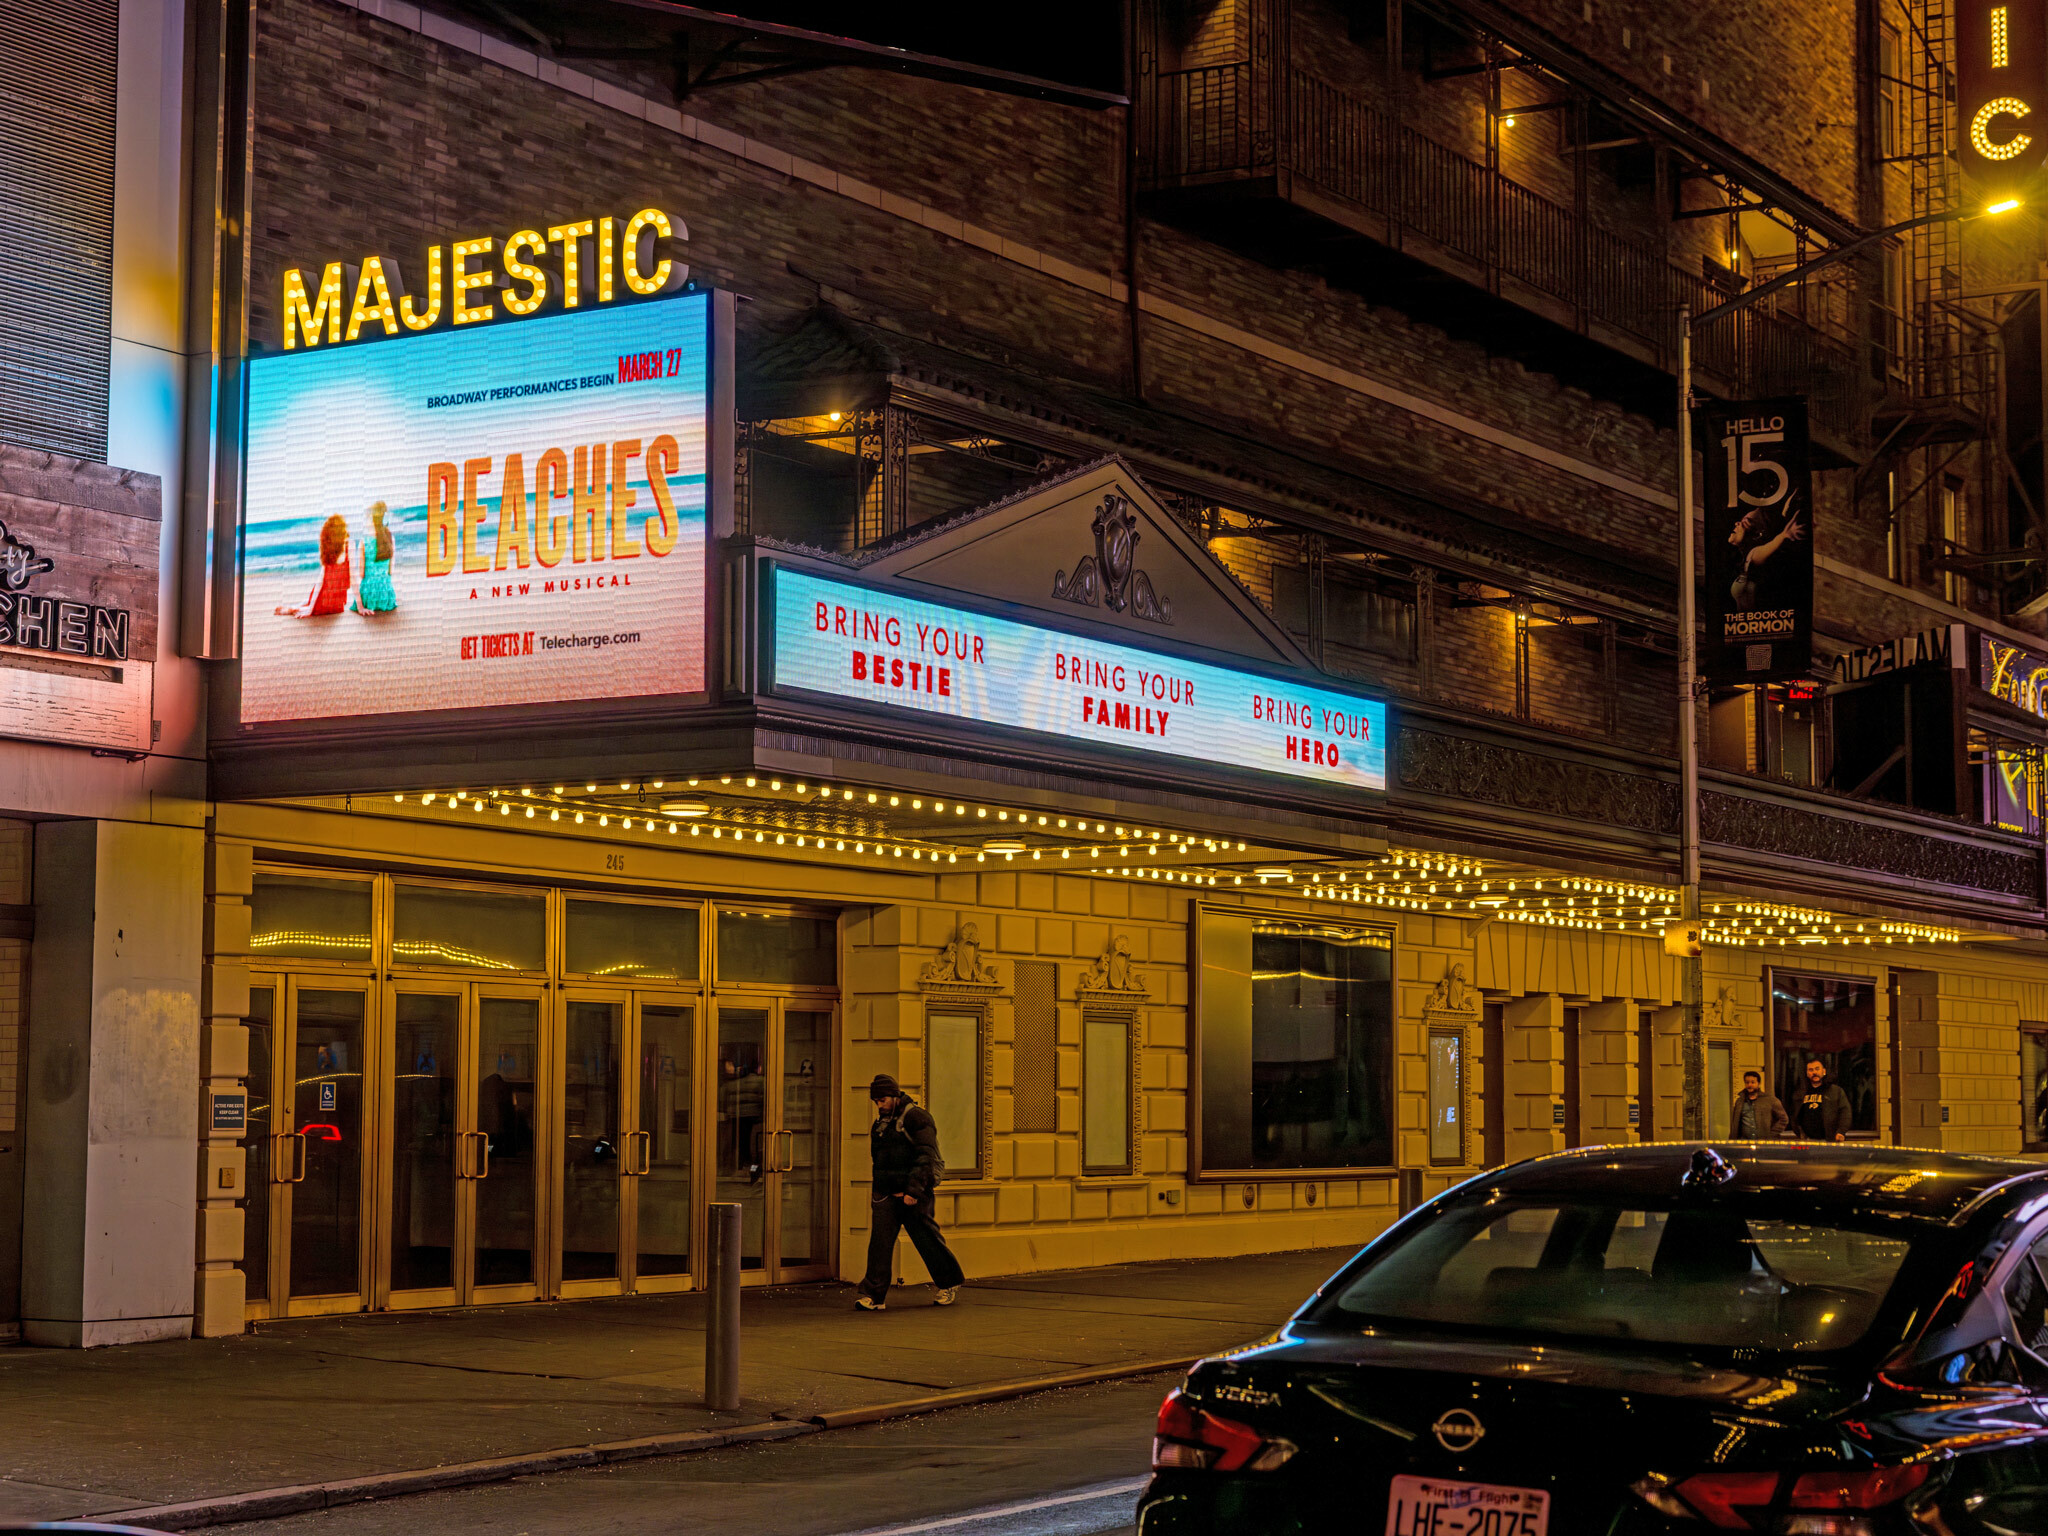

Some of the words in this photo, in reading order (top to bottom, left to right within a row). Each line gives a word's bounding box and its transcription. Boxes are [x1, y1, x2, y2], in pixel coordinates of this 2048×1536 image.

[282, 208, 673, 350] MAJESTIC
[427, 389, 488, 409] BROADWAY
[490, 377, 578, 401] PERFORMANCES
[580, 373, 615, 390] BEGIN
[618, 350, 663, 384] MARCH
[666, 348, 682, 377] 27
[1726, 416, 1785, 435] HELLO
[1721, 432, 1789, 508] 15
[426, 434, 680, 578] BEACHES
[470, 588, 478, 600] A
[492, 583, 530, 598] NEW
[544, 574, 631, 593] MUSICAL
[816, 601, 901, 647] BRING
[916, 622, 984, 664] YOUR
[1724, 612, 1745, 622] THE
[1747, 610, 1778, 620] BOOK
[1779, 609, 1795, 619] OF
[1724, 618, 1795, 635] MORMON
[461, 637, 479, 660] GET
[481, 632, 520, 659] TICKETS
[522, 631, 535, 655] AT
[540, 631, 641, 650] Telecharge.com
[852, 650, 951, 697] BESTIE
[1056, 653, 1125, 693] BRING
[1138, 670, 1194, 706] YOUR
[1083, 696, 1170, 737] FAMILY
[1253, 695, 1312, 729] BRING
[1322, 708, 1370, 741] YOUR
[1286, 735, 1339, 768] HERO
[606, 854, 624, 871] 245
